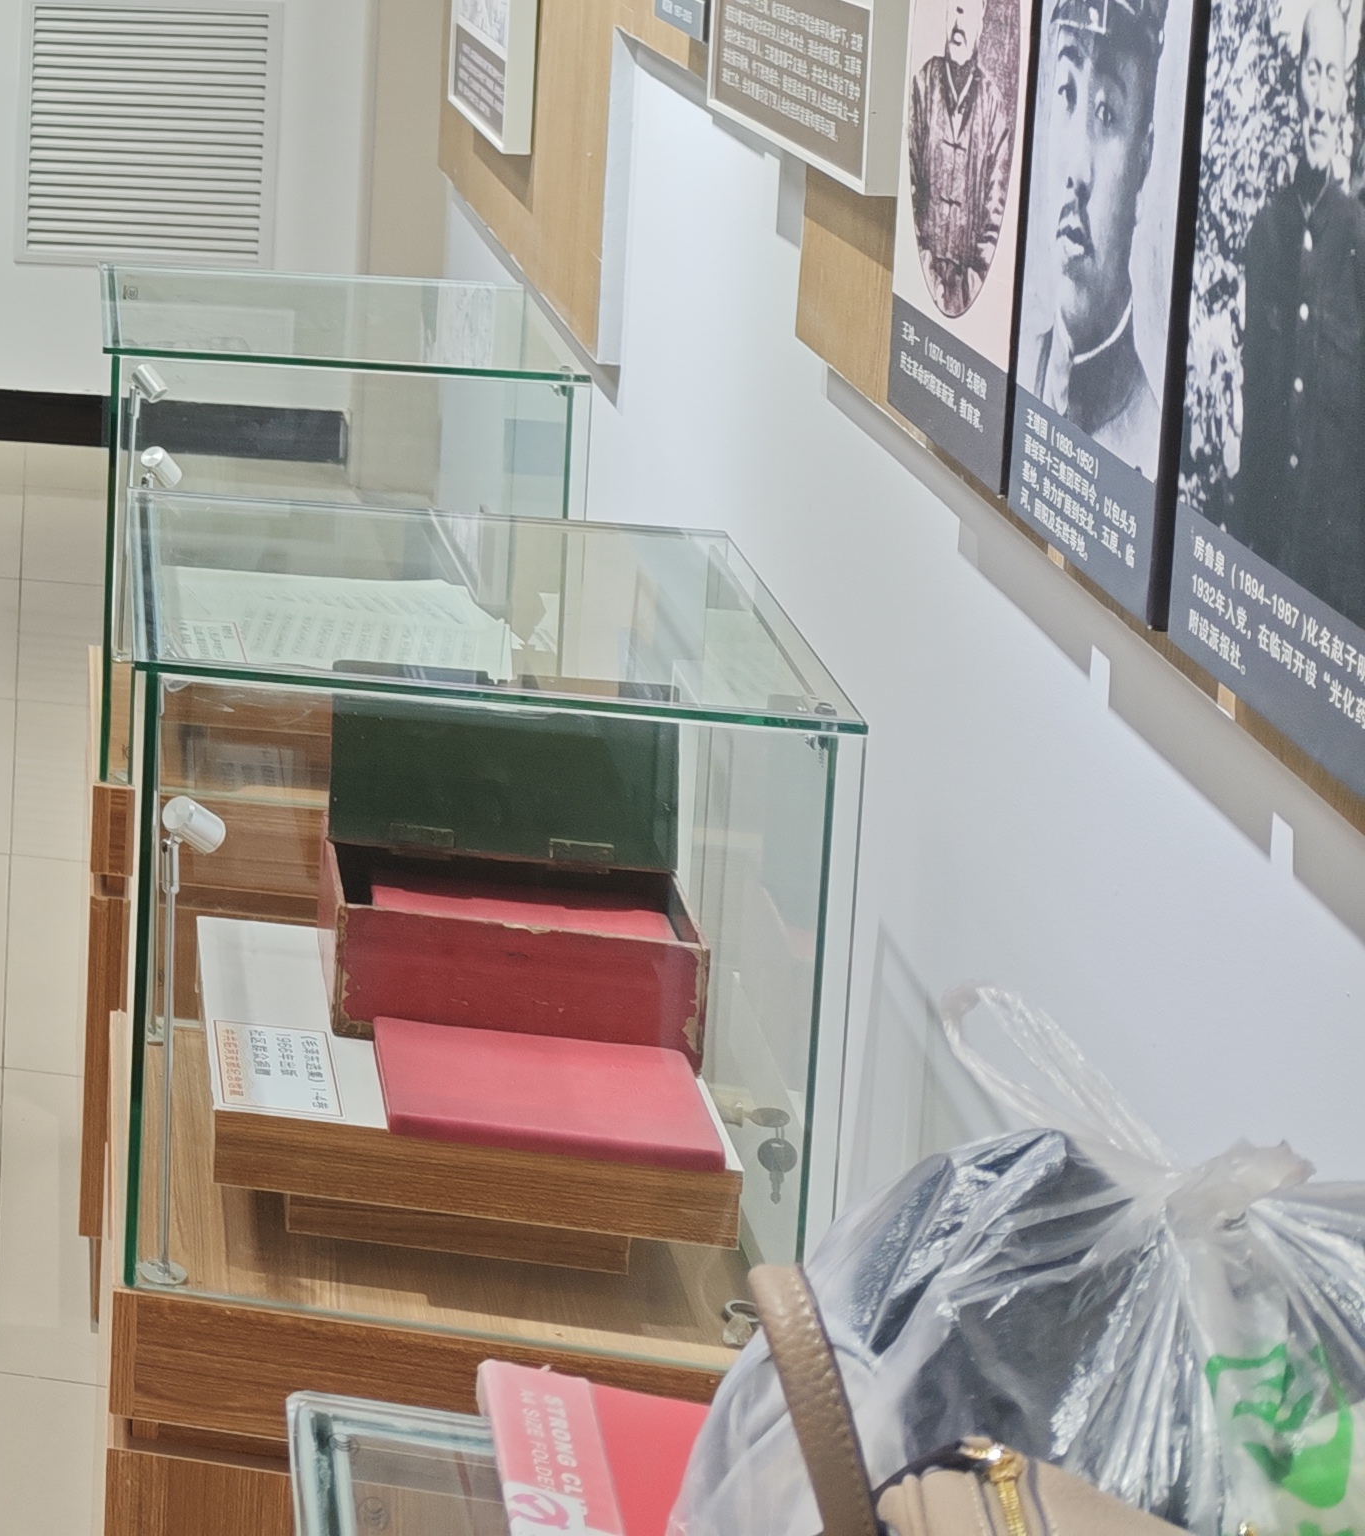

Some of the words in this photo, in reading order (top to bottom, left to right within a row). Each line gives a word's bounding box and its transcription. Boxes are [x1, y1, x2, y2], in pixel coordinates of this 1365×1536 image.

[1188, 609, 1246, 676] 附设派报社。
[523, 1408, 544, 1438] SIZE
[543, 1395, 578, 1468] STRONG
